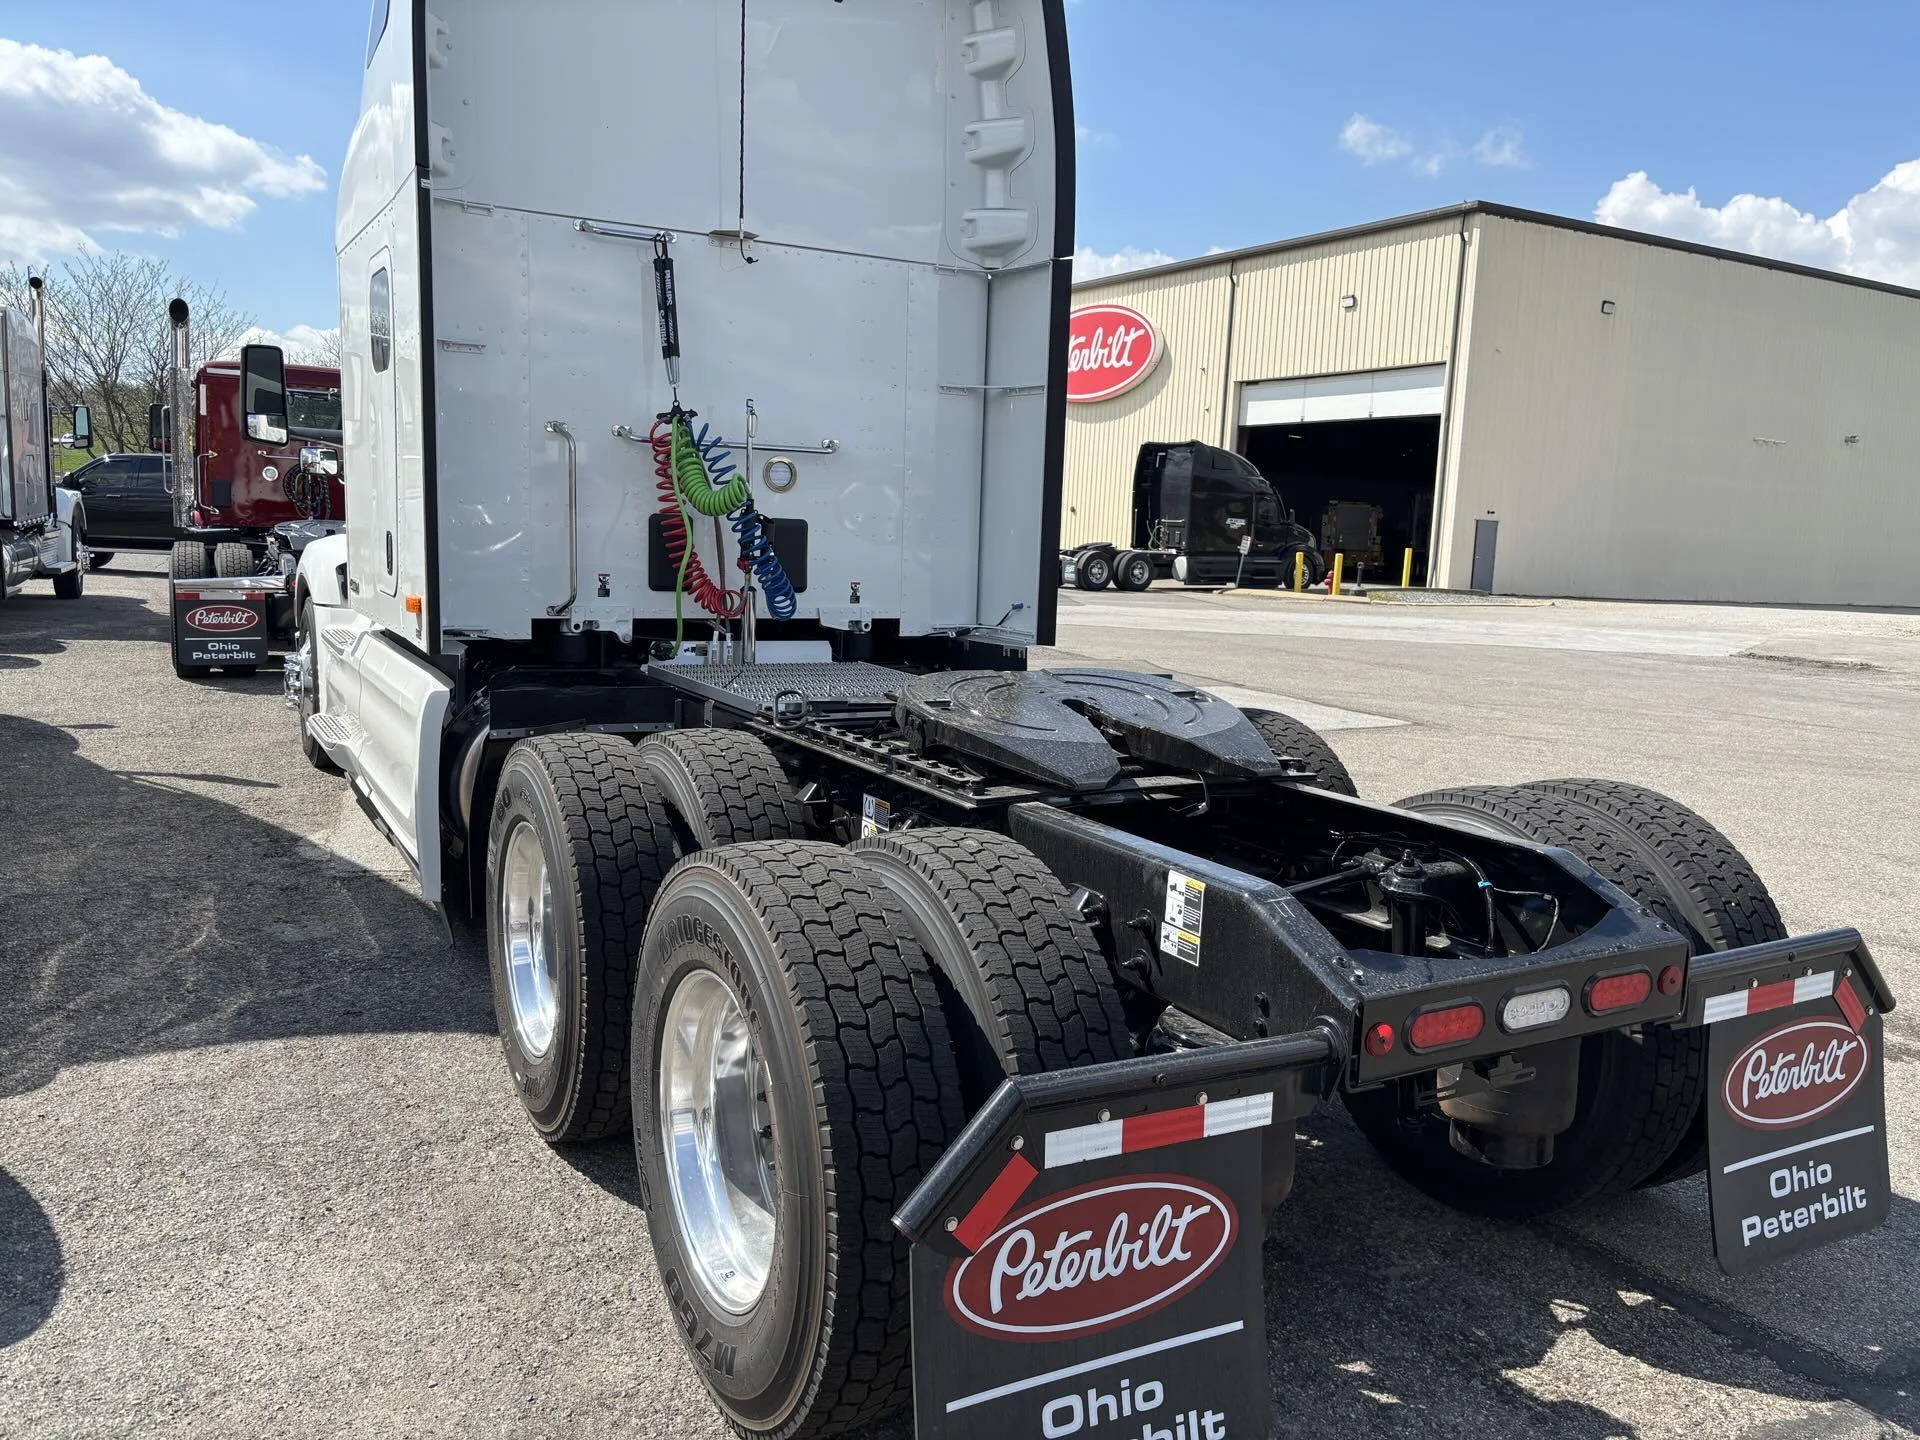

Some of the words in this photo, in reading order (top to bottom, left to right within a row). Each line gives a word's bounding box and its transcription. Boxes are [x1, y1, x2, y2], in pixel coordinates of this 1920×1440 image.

[1068, 324, 1145, 373] terbilt
[195, 610, 252, 625] Peterbilt
[192, 651, 256, 660] Peterbilt
[207, 642, 240, 650] Ohio
[1742, 1038, 1857, 1108] Peterbilt
[1769, 1160, 1832, 1199] Ohio
[1741, 1185, 1867, 1247] Peterbilt
[990, 1204, 1211, 1314] Peterbilt
[1042, 1379, 1164, 1439] Ohio
